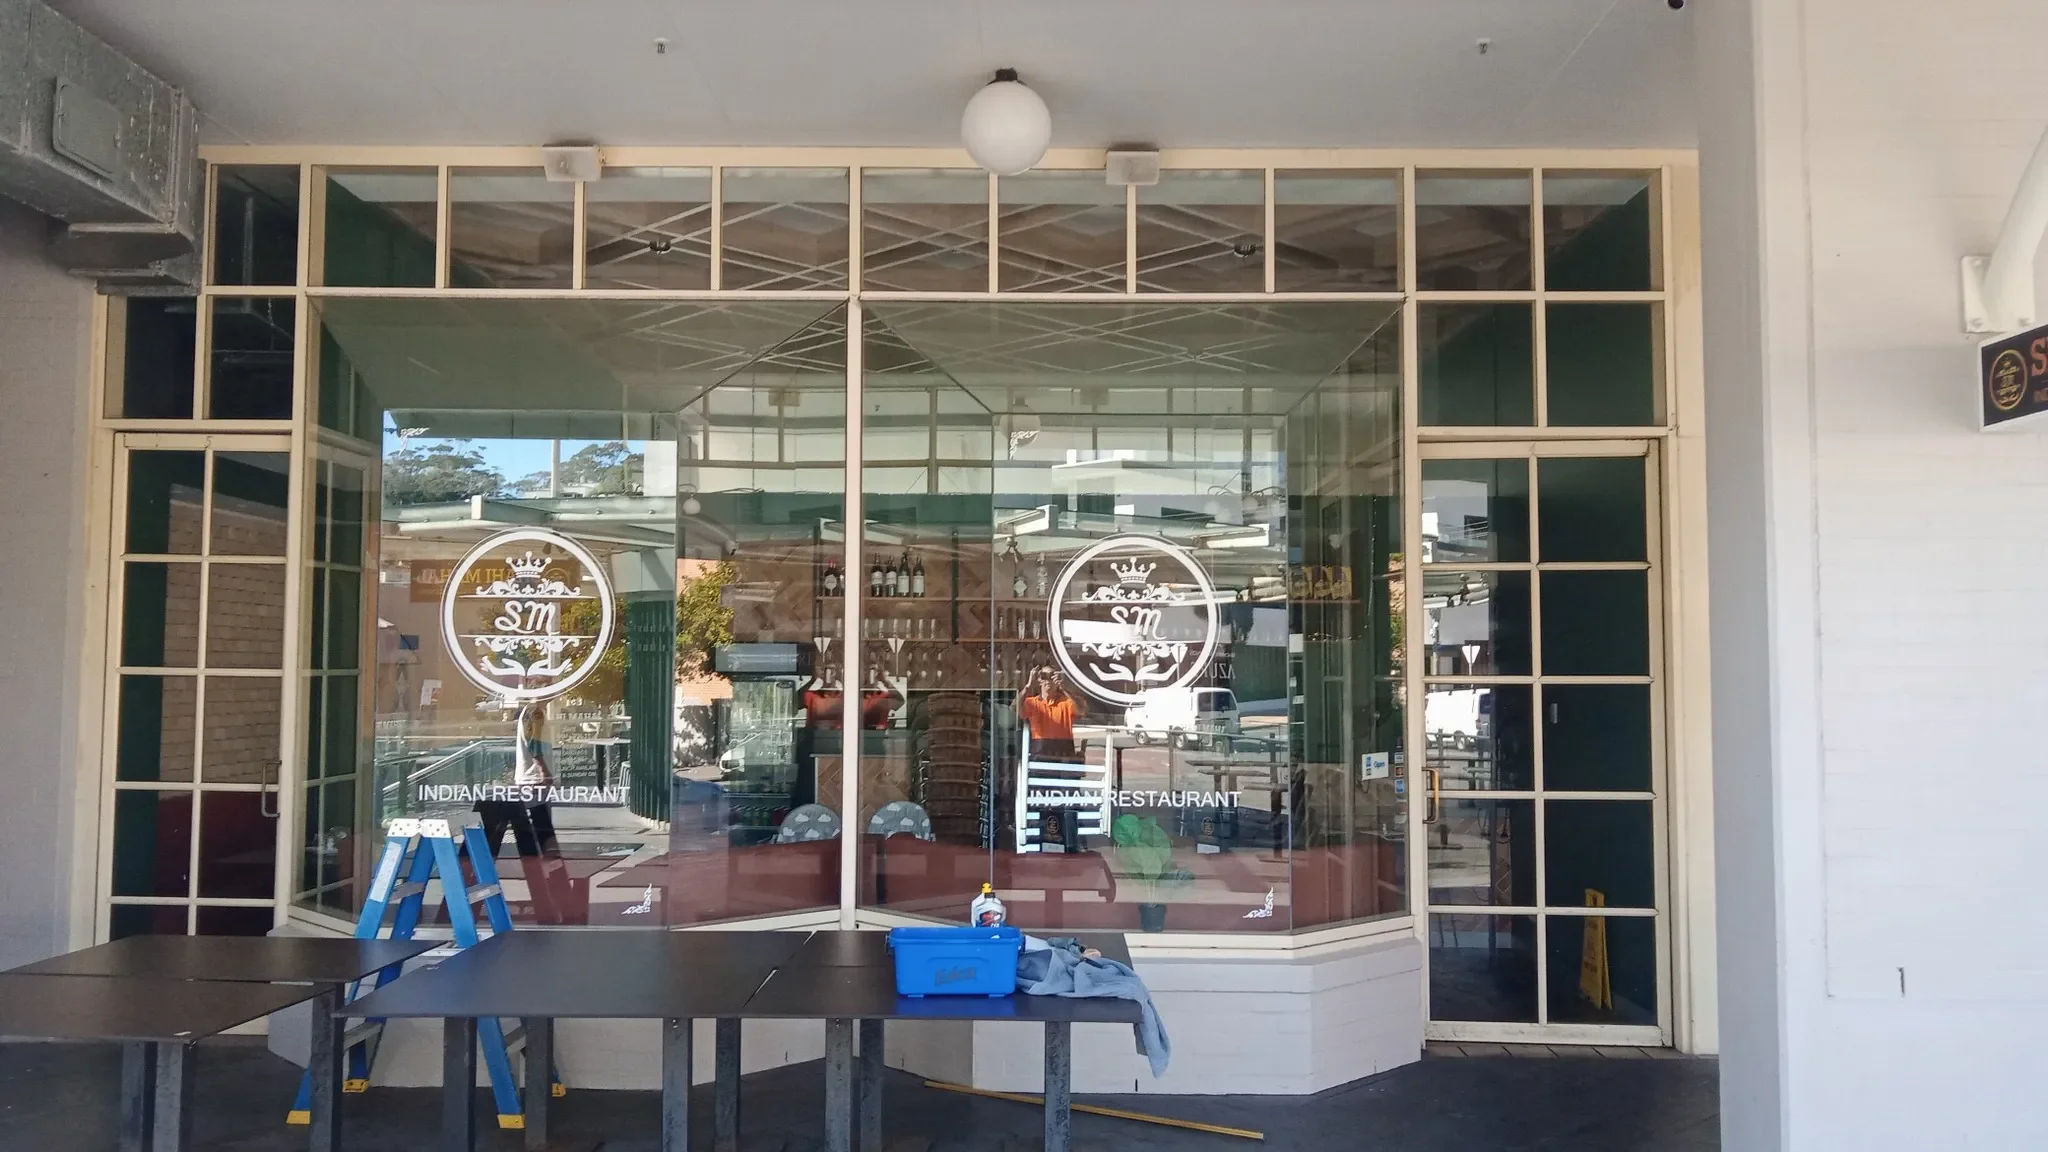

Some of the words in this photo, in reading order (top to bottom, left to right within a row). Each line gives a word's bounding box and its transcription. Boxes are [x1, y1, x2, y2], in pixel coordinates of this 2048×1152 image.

[2031, 337, 2048, 377] S
[494, 600, 560, 636] SM
[419, 785, 486, 801] INDIAN
[492, 785, 630, 802] RESTAURANT
[1029, 791, 1098, 807] INDIAN
[1105, 791, 1242, 808] RESTAURANT
